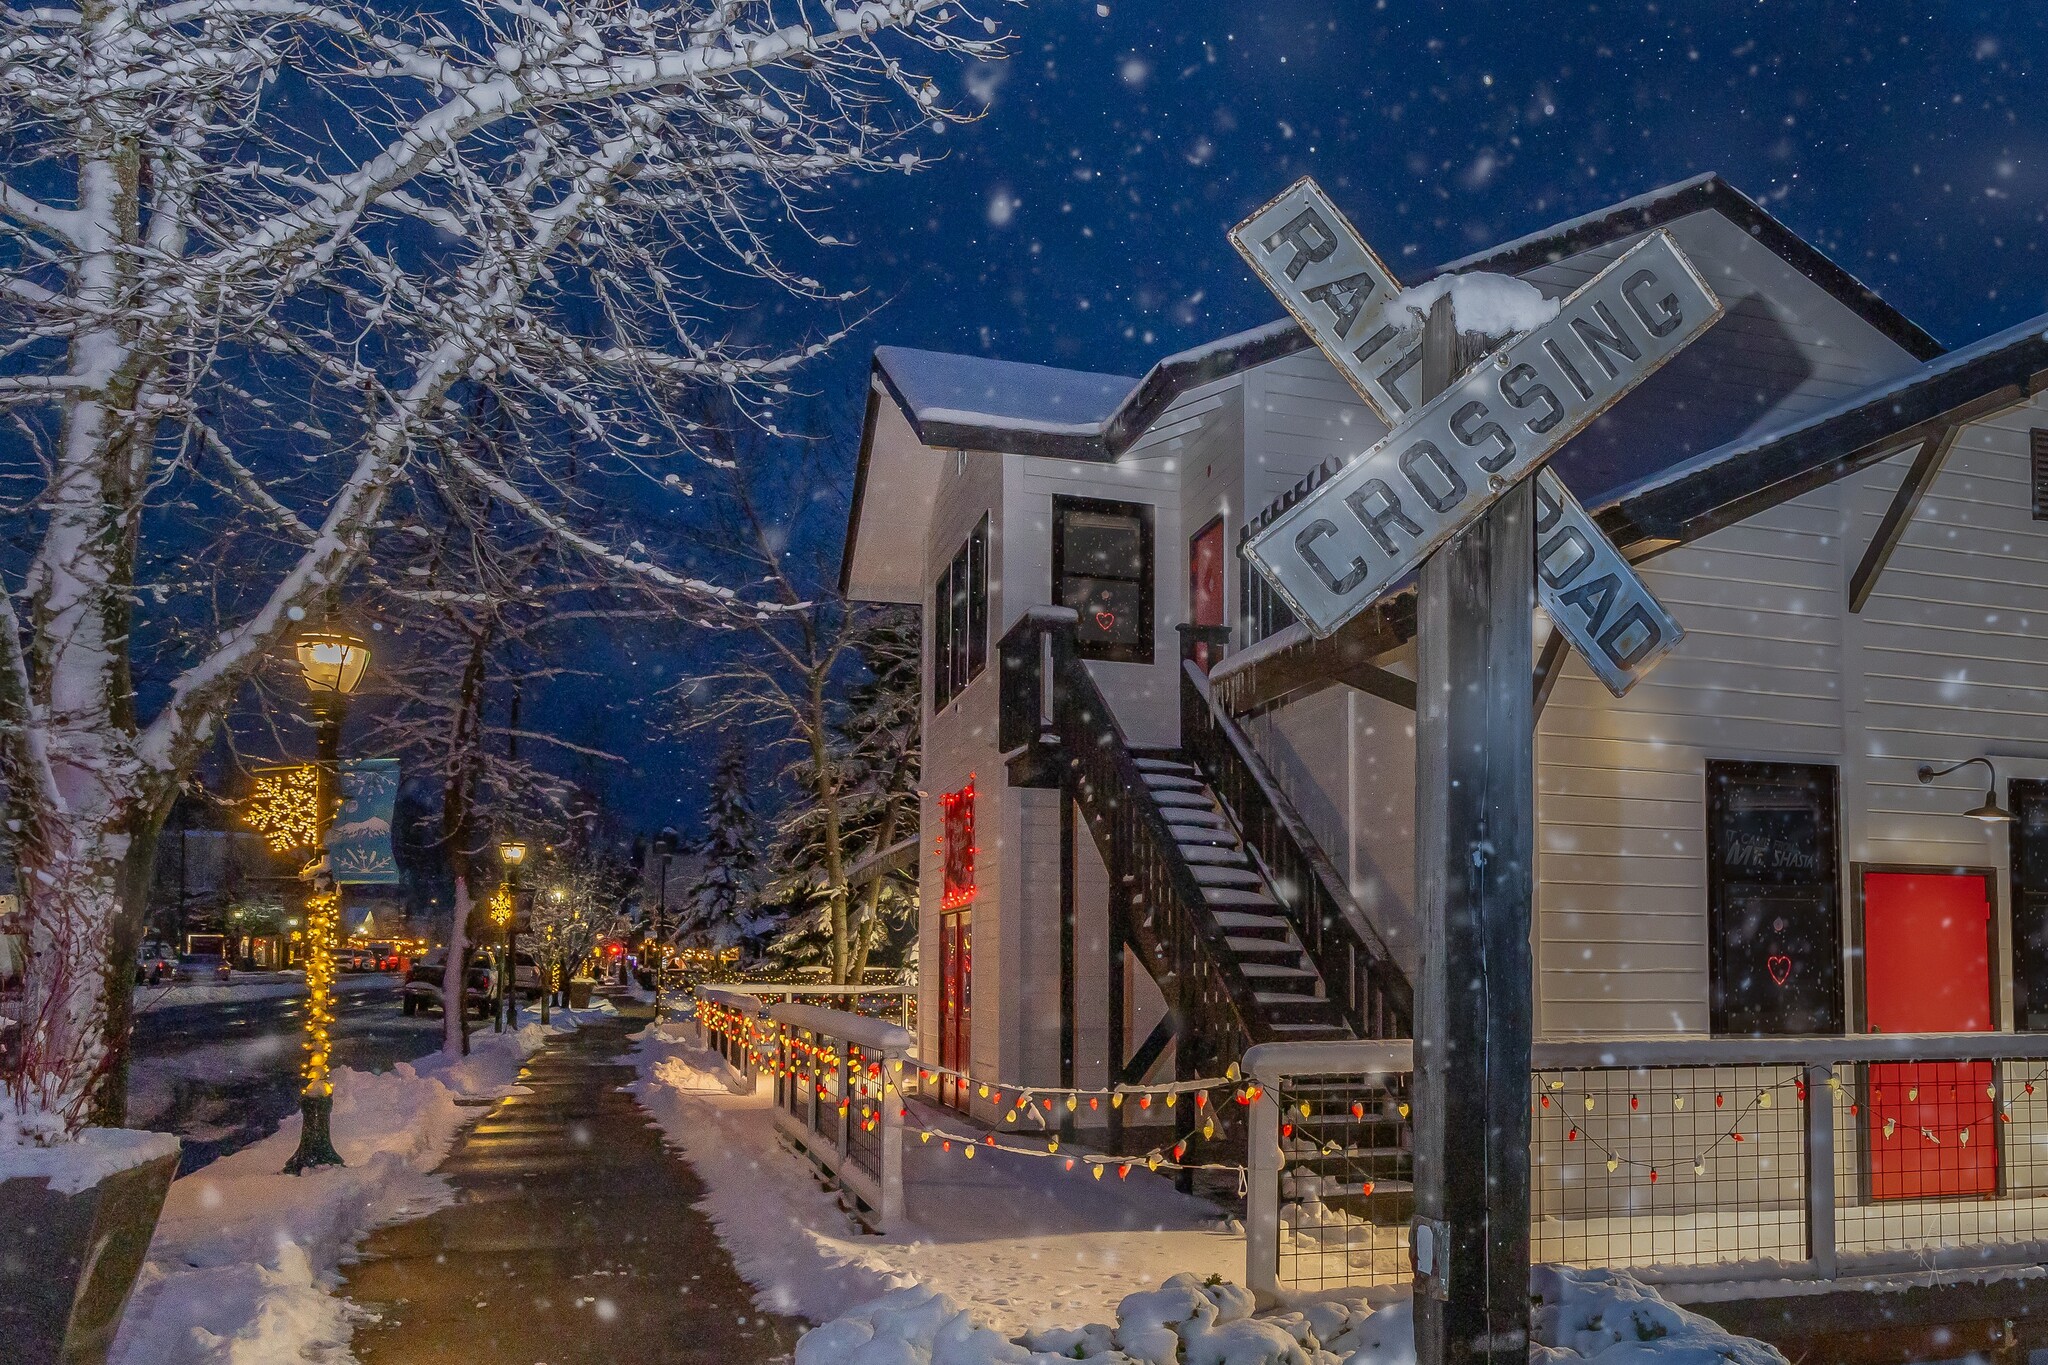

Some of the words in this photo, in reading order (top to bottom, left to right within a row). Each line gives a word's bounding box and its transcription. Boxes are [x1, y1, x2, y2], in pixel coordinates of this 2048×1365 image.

[1260, 206, 1423, 414] RAIL
[1294, 268, 1684, 596] CROSSING
[1771, 849, 1813, 867] SHASTA
